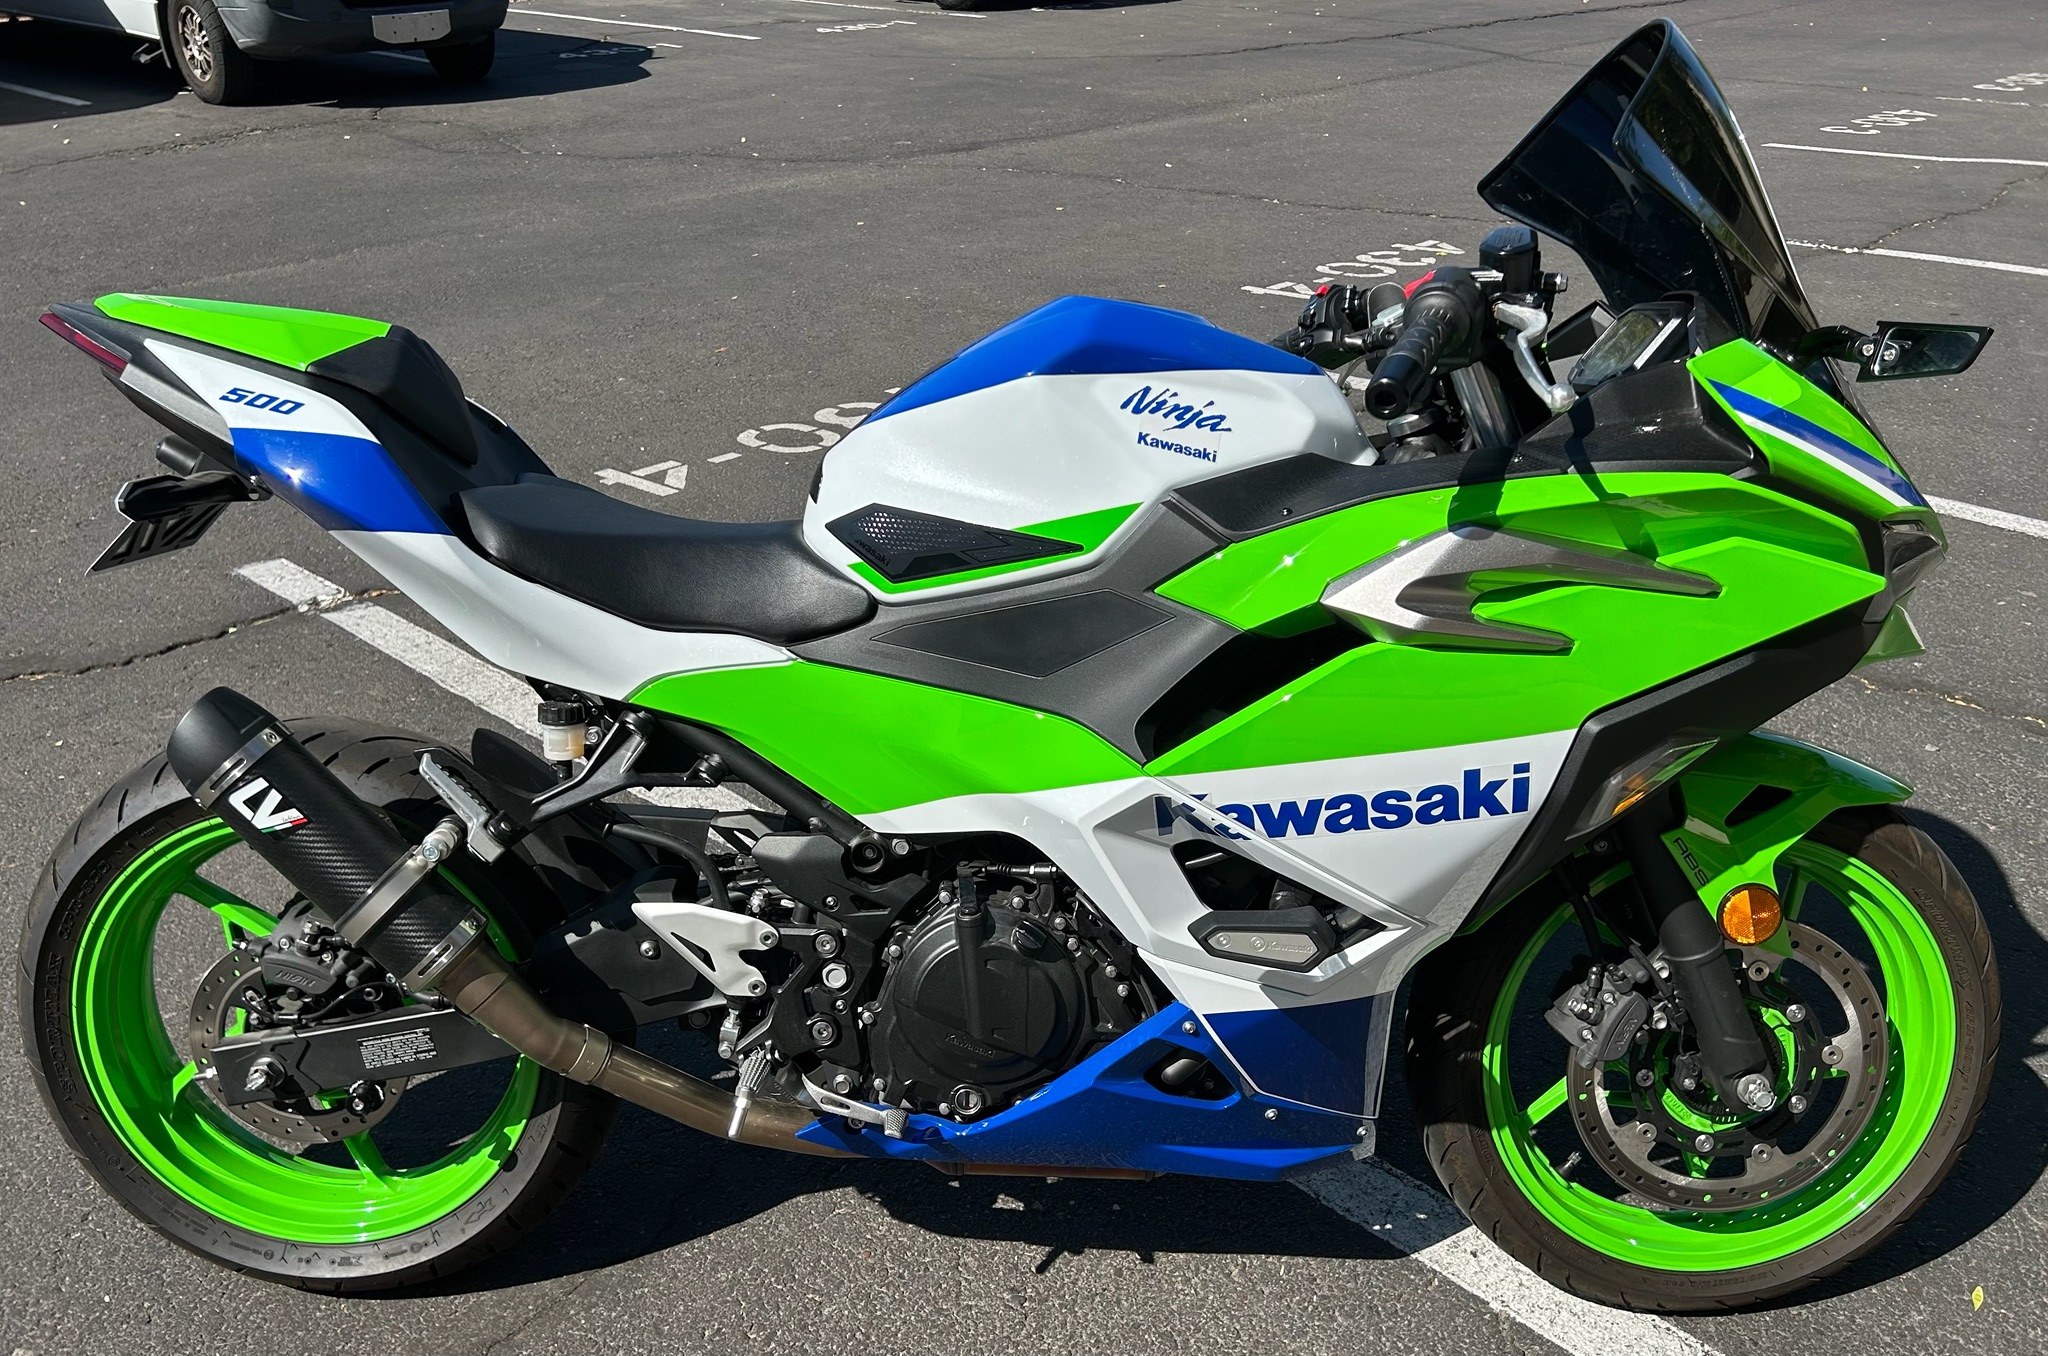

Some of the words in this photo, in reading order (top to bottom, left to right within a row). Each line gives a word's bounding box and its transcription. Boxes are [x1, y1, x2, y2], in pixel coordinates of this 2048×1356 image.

[1240, 239, 1466, 300] 430-4
[219, 387, 305, 415] 500
[1120, 385, 1232, 432] Ninja
[1137, 431, 1218, 463] Kawasaki
[228, 776, 305, 830] LV
[1154, 761, 1531, 841] Kawasaki
[1672, 836, 1709, 887] ABS
[1917, 888, 1974, 992] SPORTMAX
